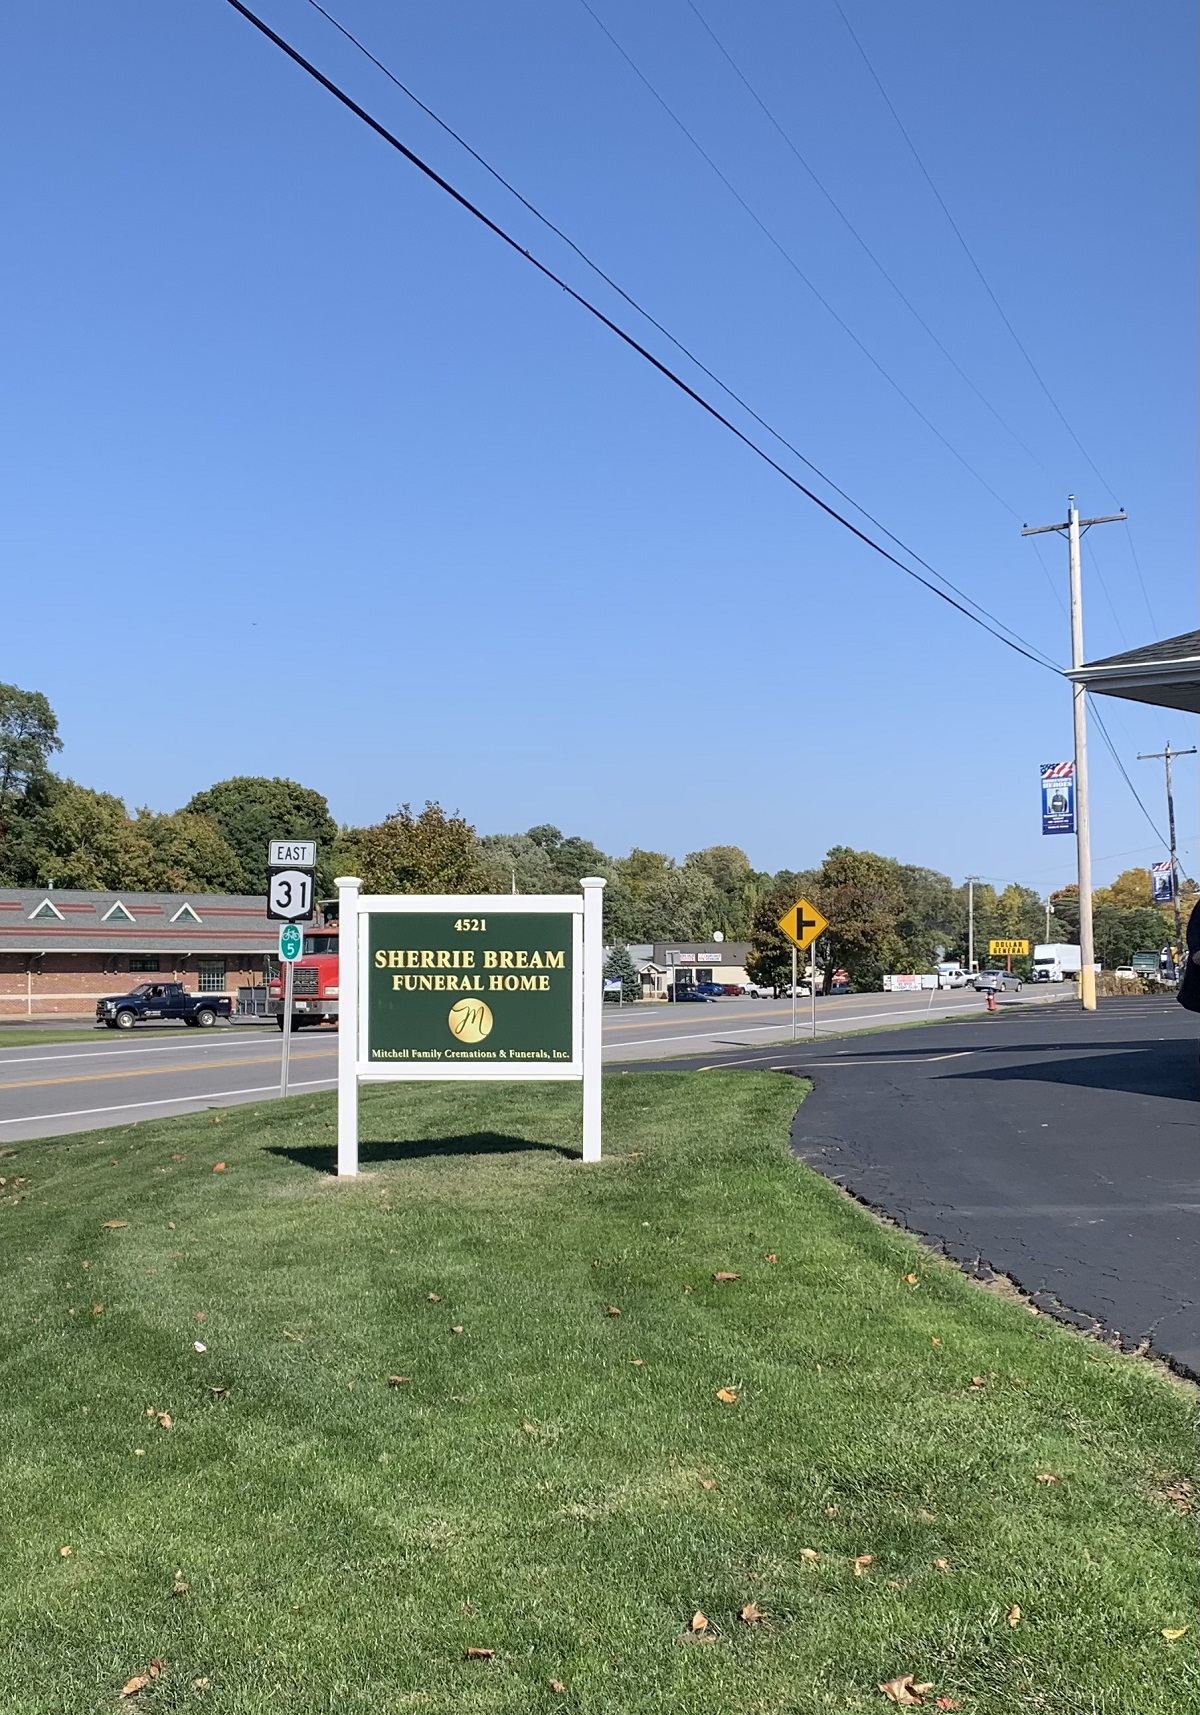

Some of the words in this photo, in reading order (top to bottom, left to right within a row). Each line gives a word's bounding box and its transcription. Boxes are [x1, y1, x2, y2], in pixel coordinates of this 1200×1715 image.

[277, 846, 307, 861] EAST
[275, 880, 307, 908] 31
[453, 918, 487, 932] 4521
[286, 943, 295, 956] 5
[375, 950, 476, 969] SHERRIE
[483, 950, 566, 969] BREAM
[392, 975, 485, 991] FUNERAL
[489, 975, 550, 991] HOME
[372, 1049, 409, 1058] Mitchell
[411, 1049, 442, 1060] Family
[444, 1049, 497, 1058] Cremations
[499, 1049, 507, 1058] &
[509, 1049, 551, 1060] Funerals,
[552, 1049, 570, 1058] Inc.
